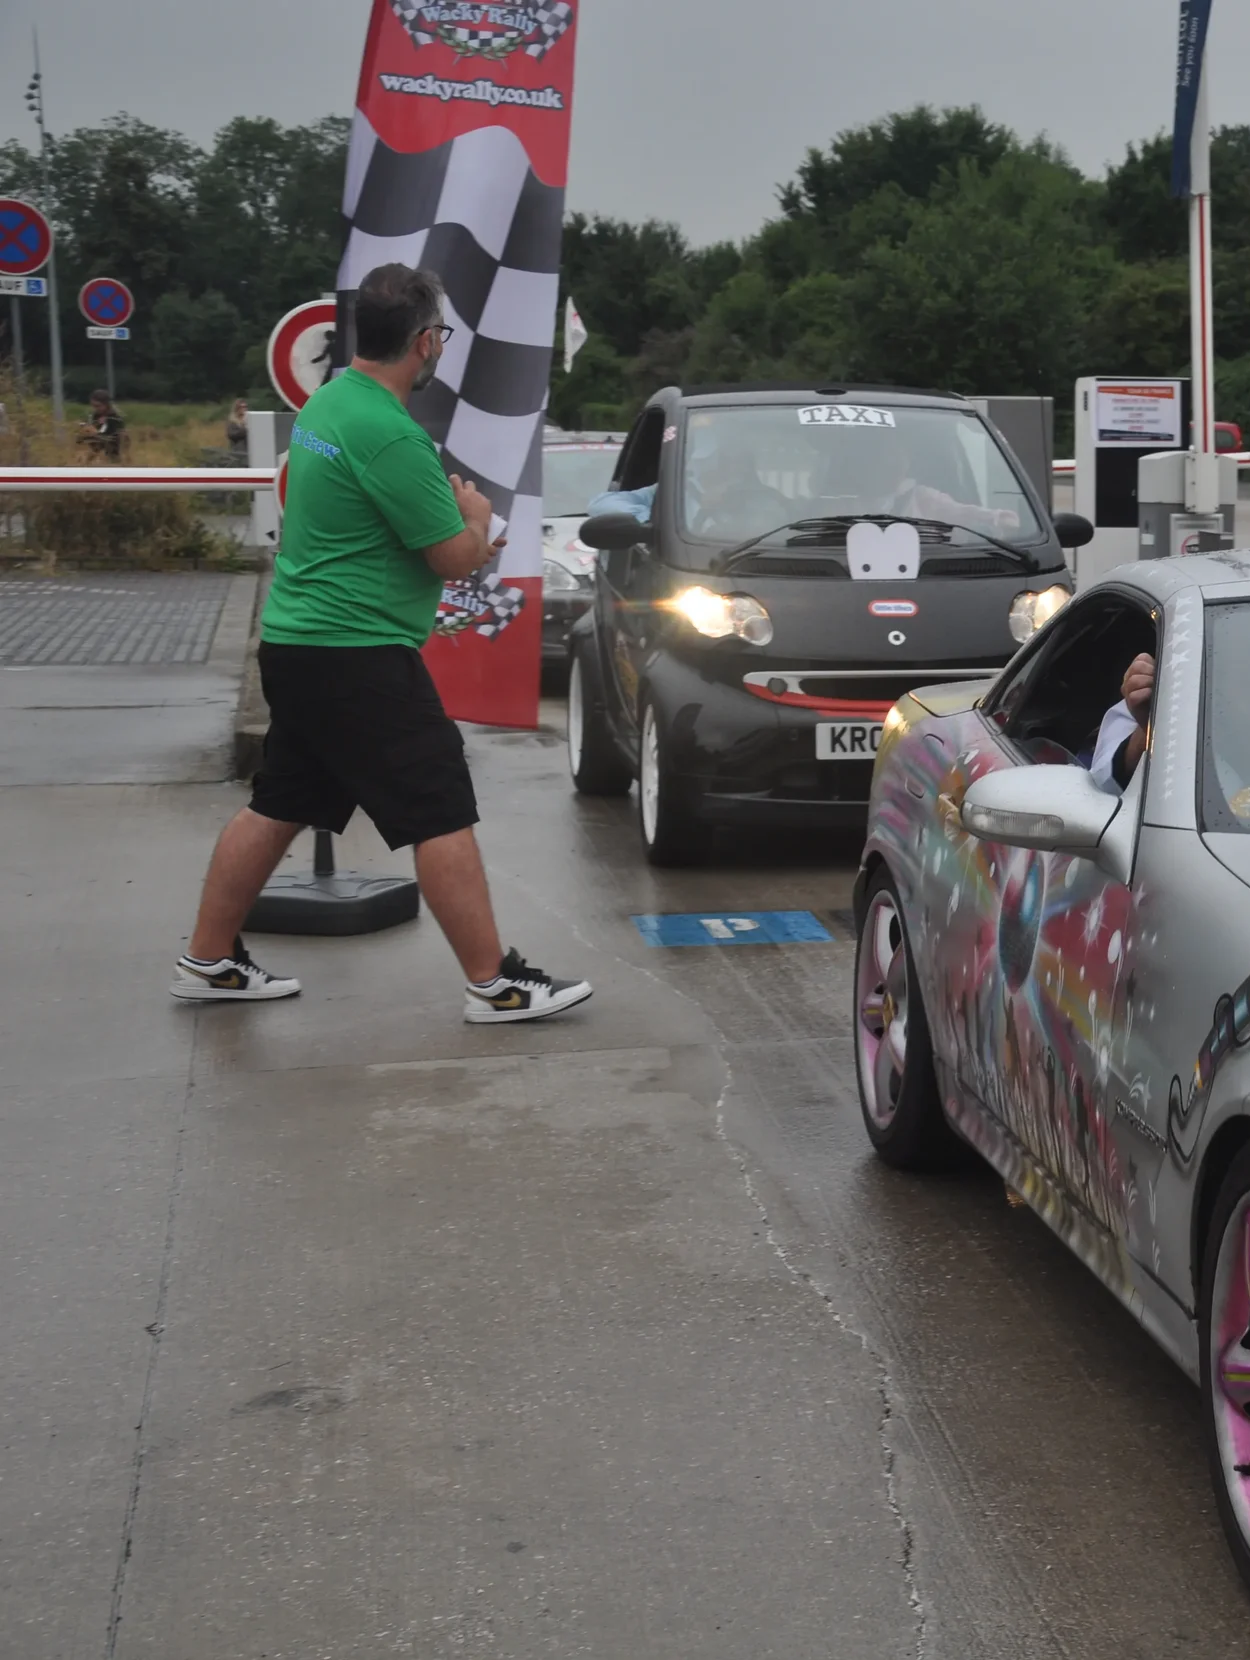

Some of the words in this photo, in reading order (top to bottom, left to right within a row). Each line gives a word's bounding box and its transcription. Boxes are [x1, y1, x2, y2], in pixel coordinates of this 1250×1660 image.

[420, 5, 483, 24] Wacky
[487, 7, 538, 34] Rally
[379, 73, 564, 108] wackyrally.co.uk
[802, 406, 893, 427] TAXI
[304, 431, 340, 460] Crew
